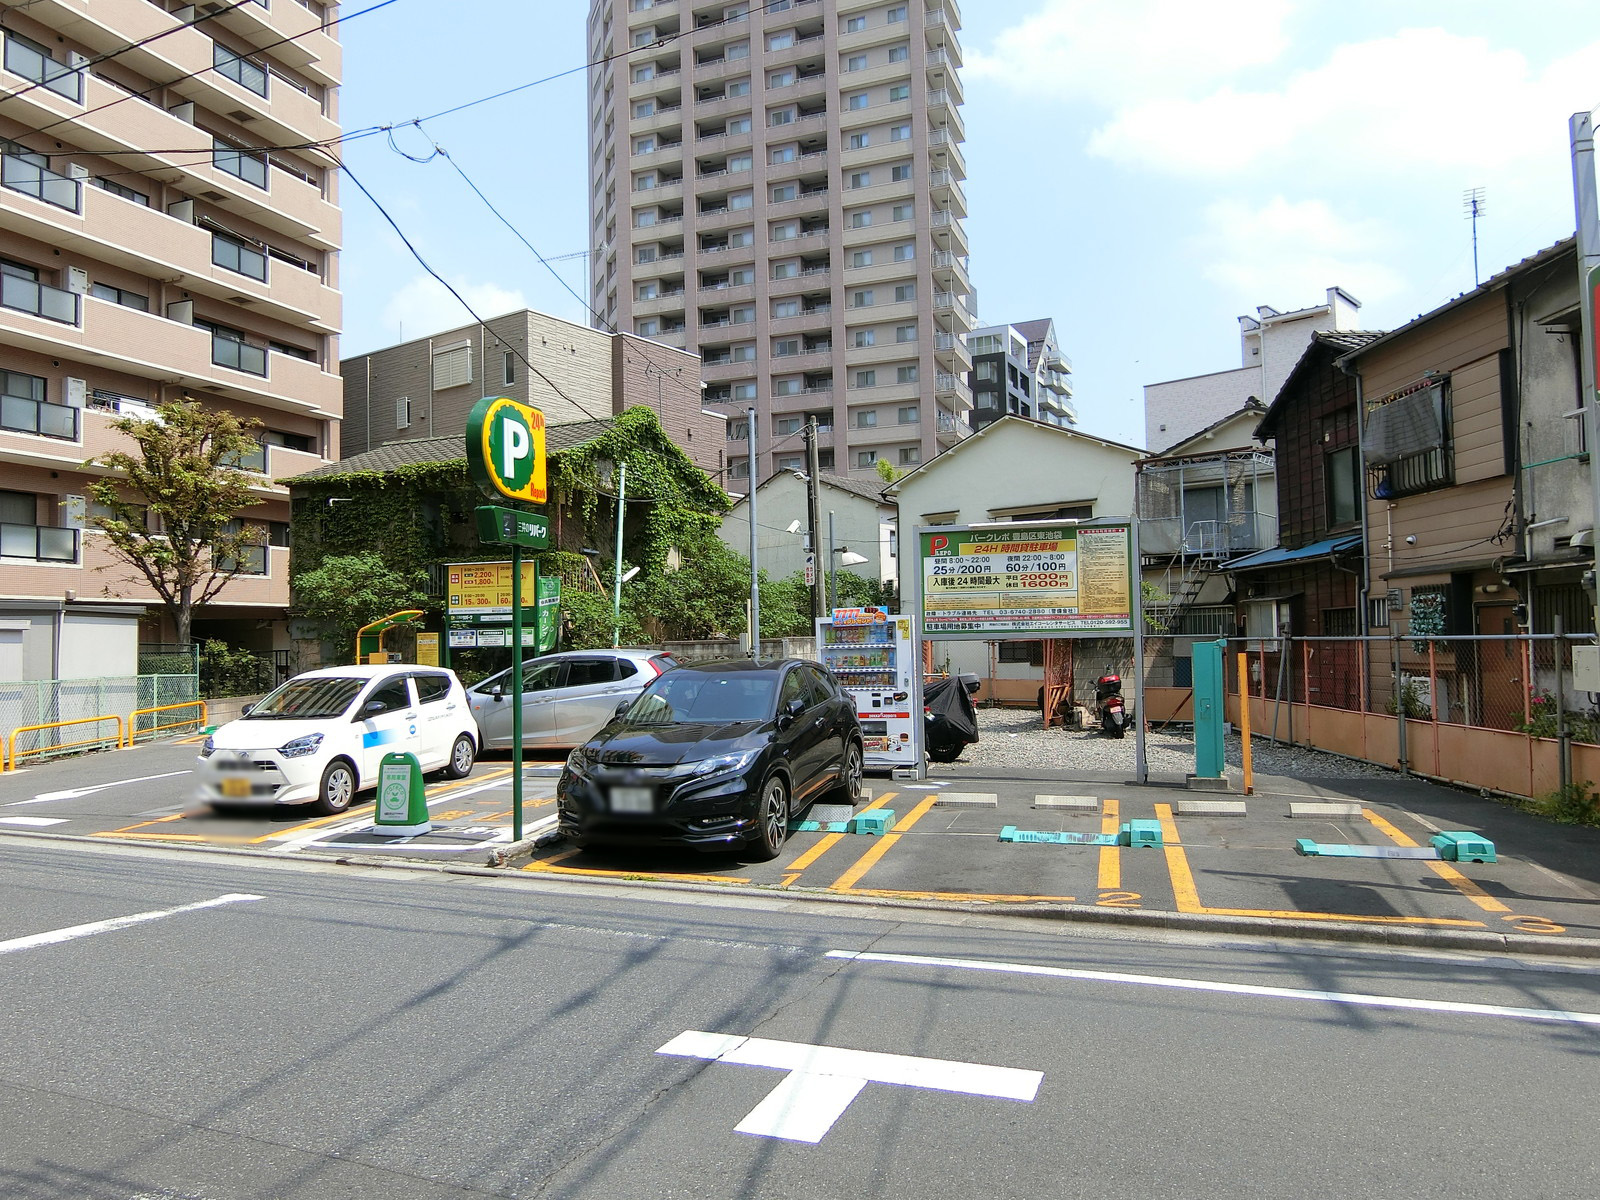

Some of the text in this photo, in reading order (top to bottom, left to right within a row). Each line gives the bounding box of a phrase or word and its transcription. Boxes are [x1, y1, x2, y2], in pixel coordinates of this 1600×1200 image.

[503, 417, 529, 479] P
[1012, 531, 1063, 540] 豊島区東池袋
[974, 542, 1058, 553] 24H 時間貸駐車場
[780, 871, 803, 887] 1
[1095, 891, 1142, 908] 2
[1500, 914, 1567, 934] 3
